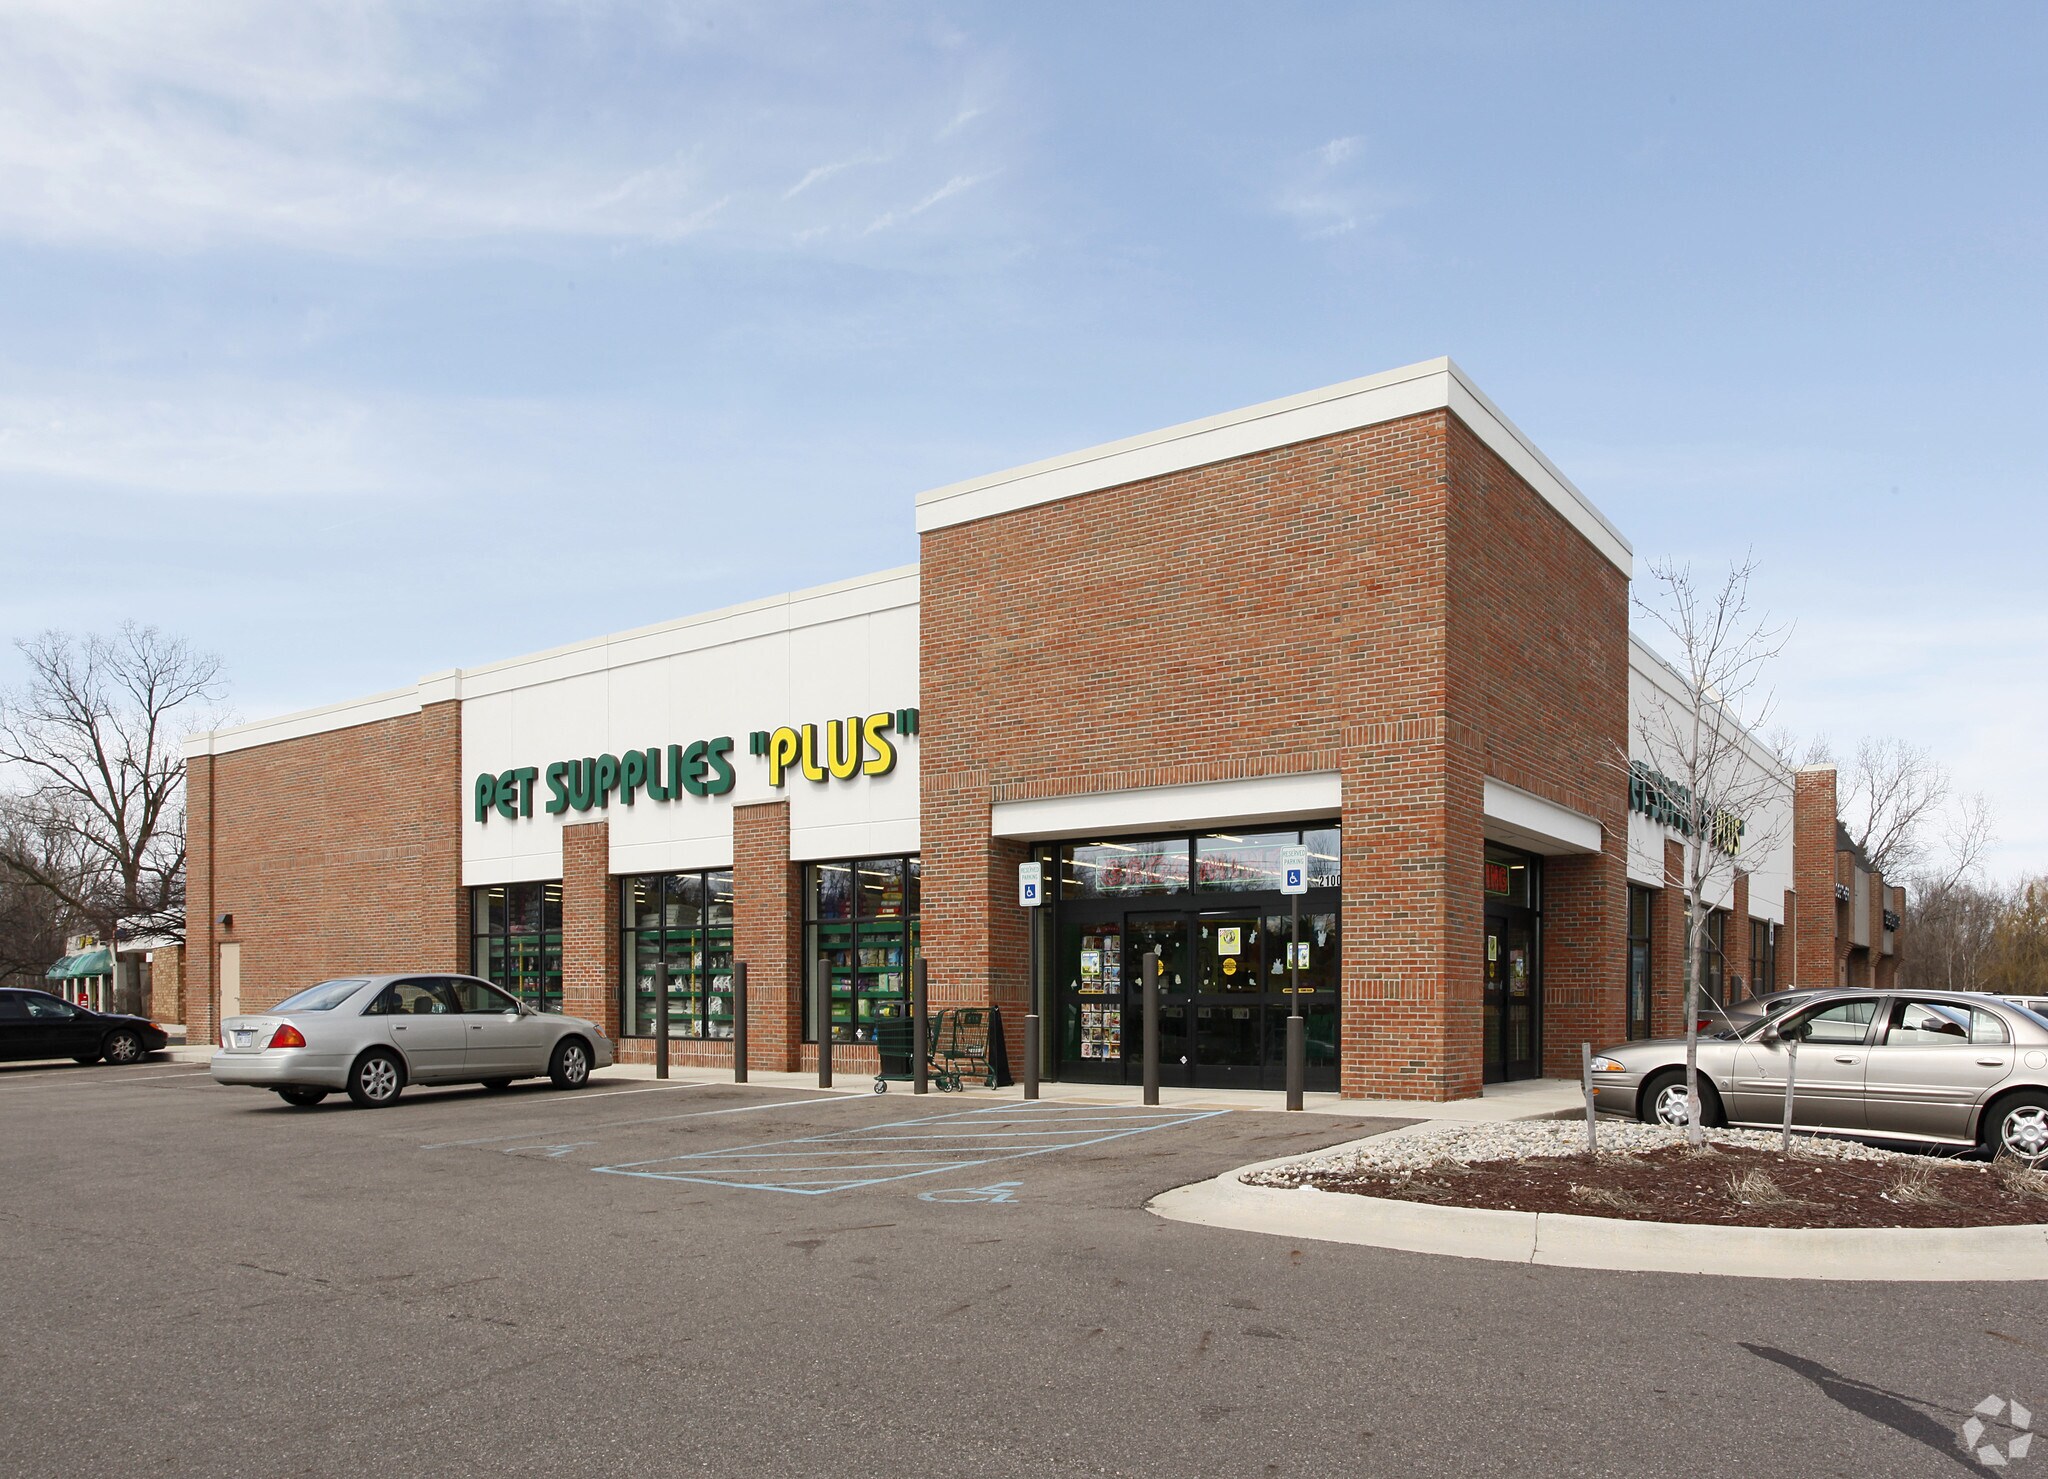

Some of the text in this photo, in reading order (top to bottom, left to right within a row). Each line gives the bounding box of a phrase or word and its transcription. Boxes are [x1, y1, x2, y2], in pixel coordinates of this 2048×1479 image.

[475, 766, 538, 823] PET
[546, 736, 736, 815] SUPPLIES
[1283, 849, 1305, 857] RESERVED
[1319, 874, 1341, 887] 2100
